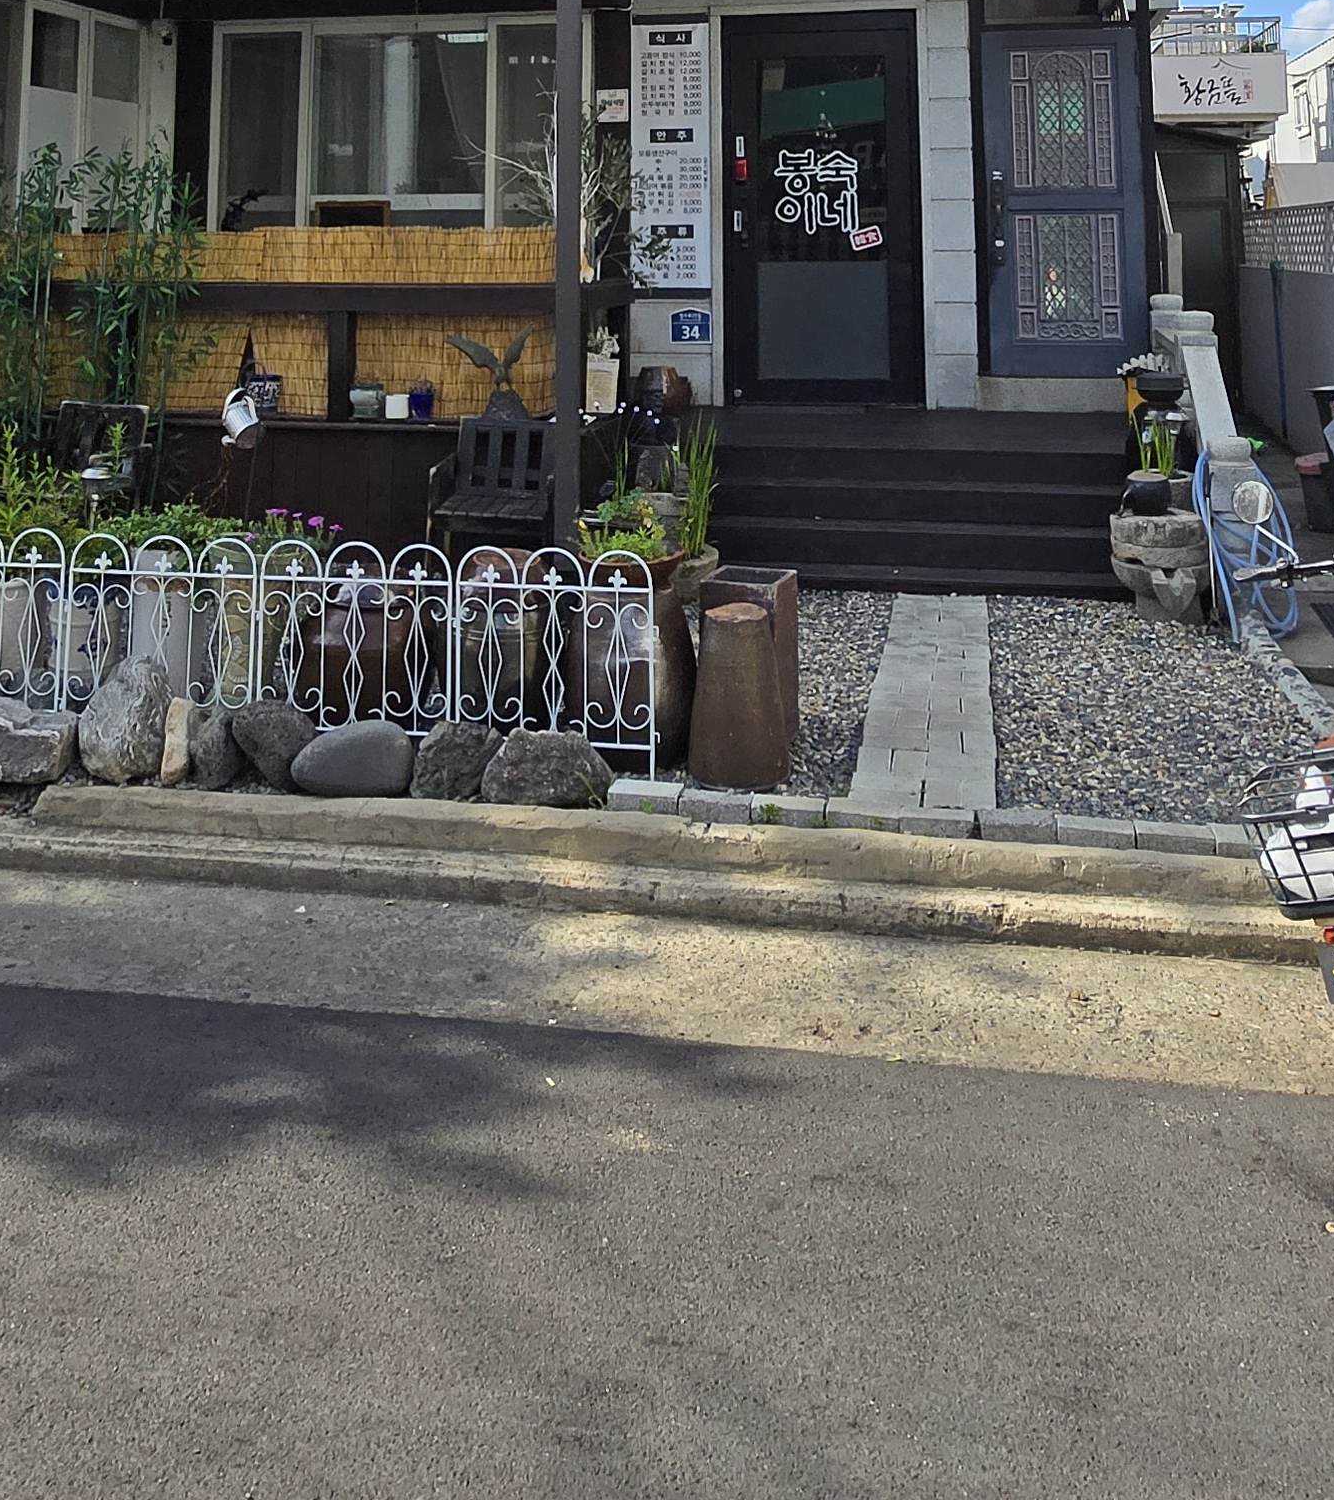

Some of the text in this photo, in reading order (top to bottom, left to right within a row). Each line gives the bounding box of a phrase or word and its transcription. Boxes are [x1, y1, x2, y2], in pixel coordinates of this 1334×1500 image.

[656, 130, 687, 141] 안주
[774, 148, 859, 196] 봉숙
[775, 190, 859, 235] 이네
[681, 325, 700, 339] 34
